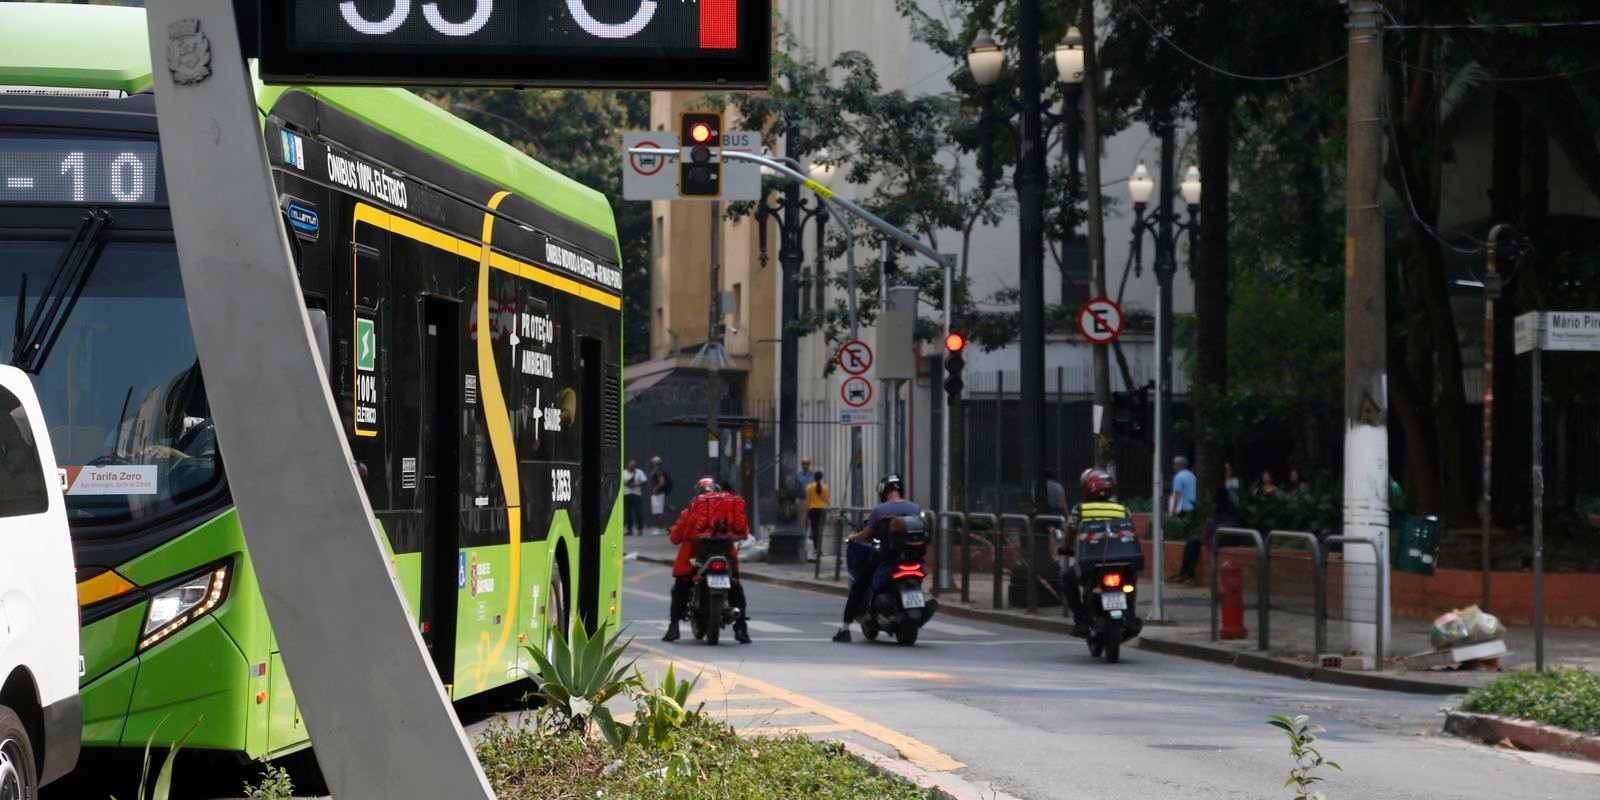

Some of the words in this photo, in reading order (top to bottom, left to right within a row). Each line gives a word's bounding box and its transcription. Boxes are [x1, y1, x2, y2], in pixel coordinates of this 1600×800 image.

[723, 135, 749, 146] BUS
[327, 146, 357, 190] ÔNIBUS
[356, 161, 375, 196] 100%
[374, 169, 407, 209] ELÉTRICO
[1553, 314, 1581, 328] Mário
[521, 350, 553, 379] AMBIENTAL
[357, 374, 377, 404] 100%
[357, 403, 377, 424] ELÉTRICO
[544, 403, 562, 431] SAÚDE
[90, 472, 118, 481] Tarifa
[120, 472, 142, 481] Zero
[551, 469, 556, 502] 3
[556, 469, 572, 502] 2653
